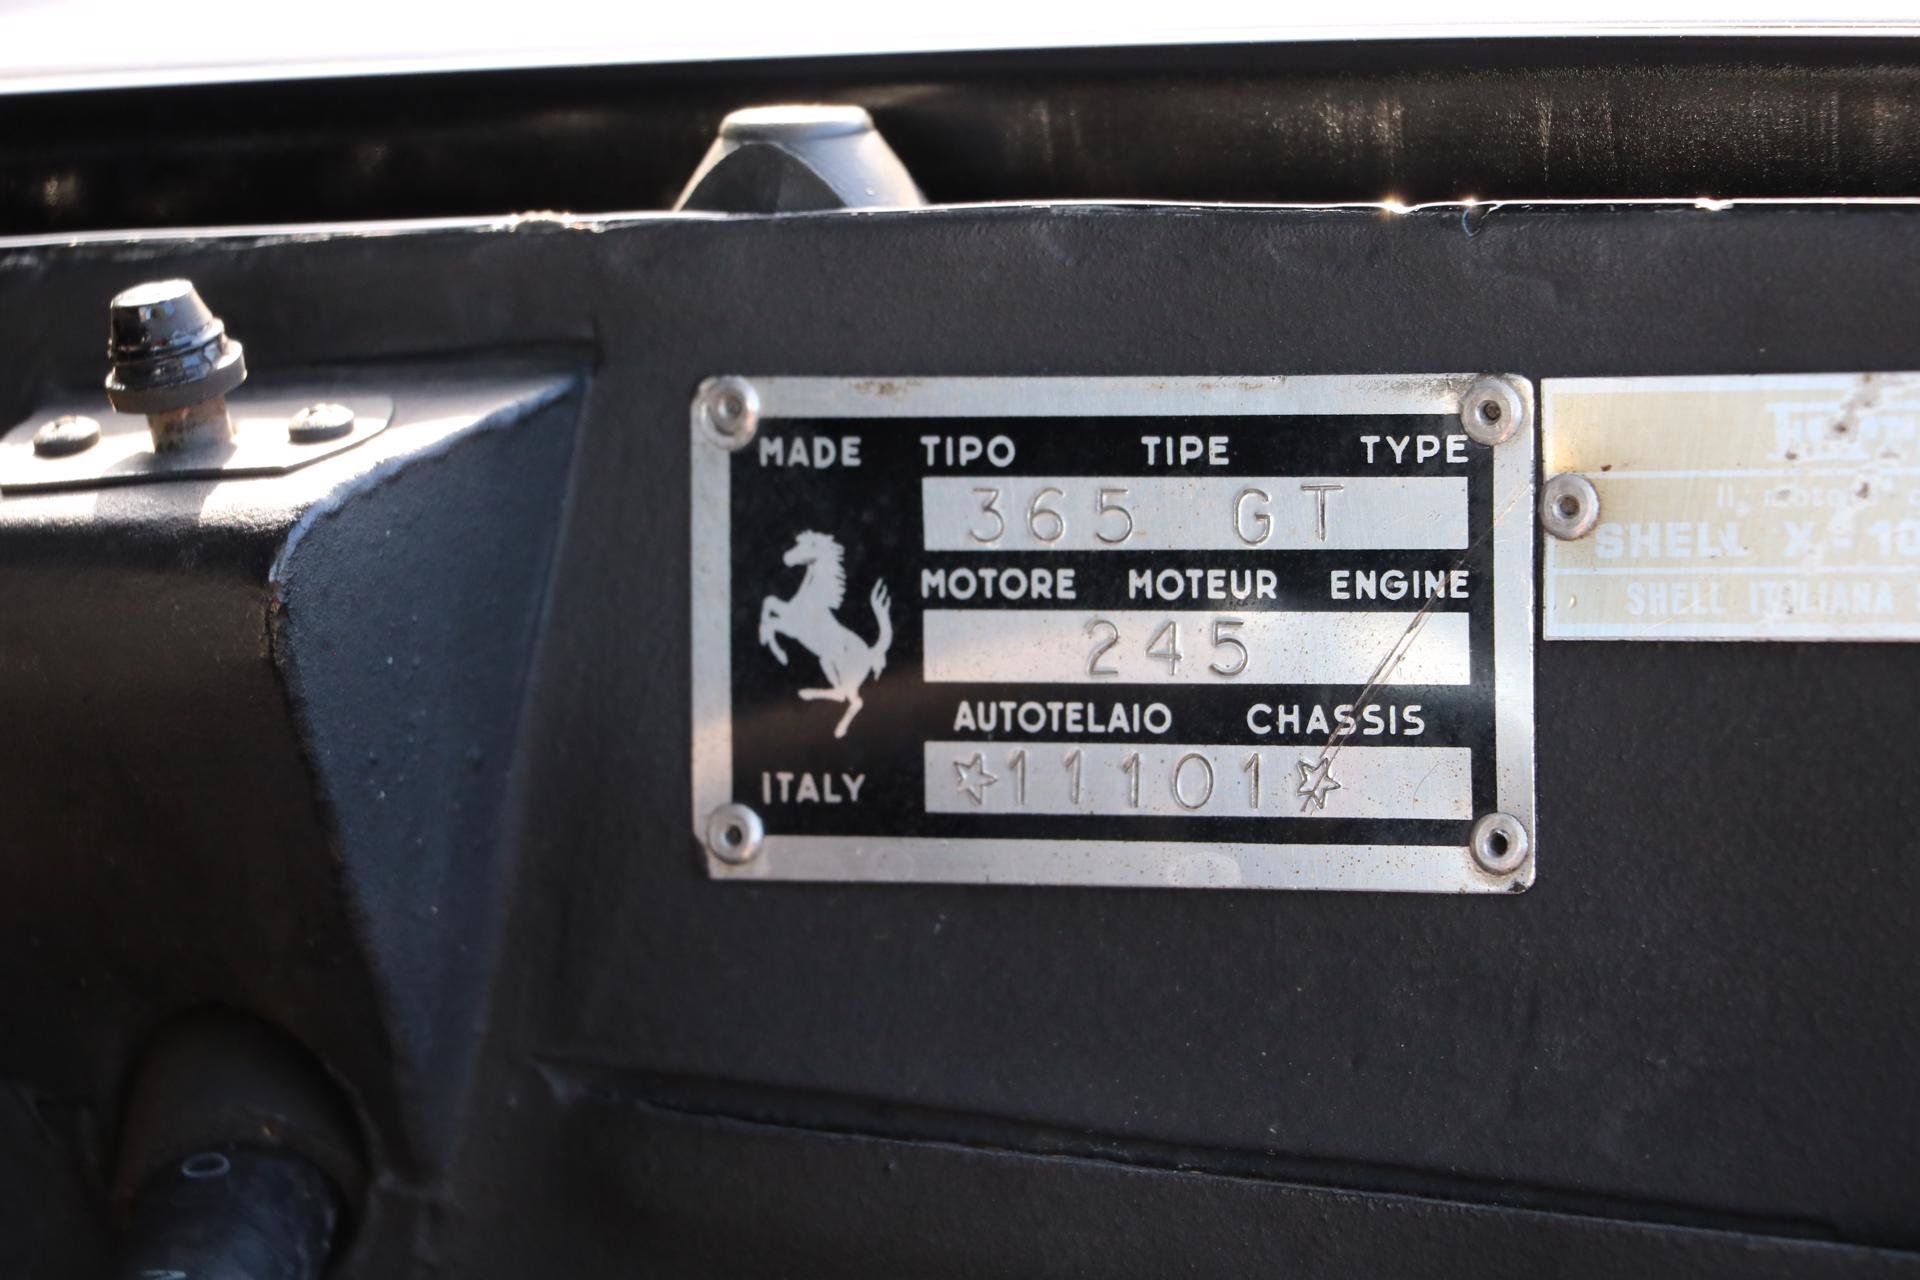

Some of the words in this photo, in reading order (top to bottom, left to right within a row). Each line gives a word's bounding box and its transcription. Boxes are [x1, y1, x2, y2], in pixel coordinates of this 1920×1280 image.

[759, 436, 862, 468] MADE
[920, 435, 1017, 468] TIPO
[1140, 435, 1230, 466] TIPE
[1360, 434, 1469, 464] TYPE
[968, 486, 1134, 545] 365
[1232, 482, 1345, 546] GT
[1594, 520, 1751, 561] SHELL
[920, 567, 1078, 600] MOTORE
[1128, 568, 1278, 601] MOTEUR
[1330, 569, 1470, 600] ENGINE
[1625, 581, 1728, 617] SHELL
[1084, 615, 1250, 677] 245
[953, 701, 1173, 734] AUTOTELAIO
[1246, 703, 1426, 736] CHASSIS
[762, 771, 867, 805] ITALY
